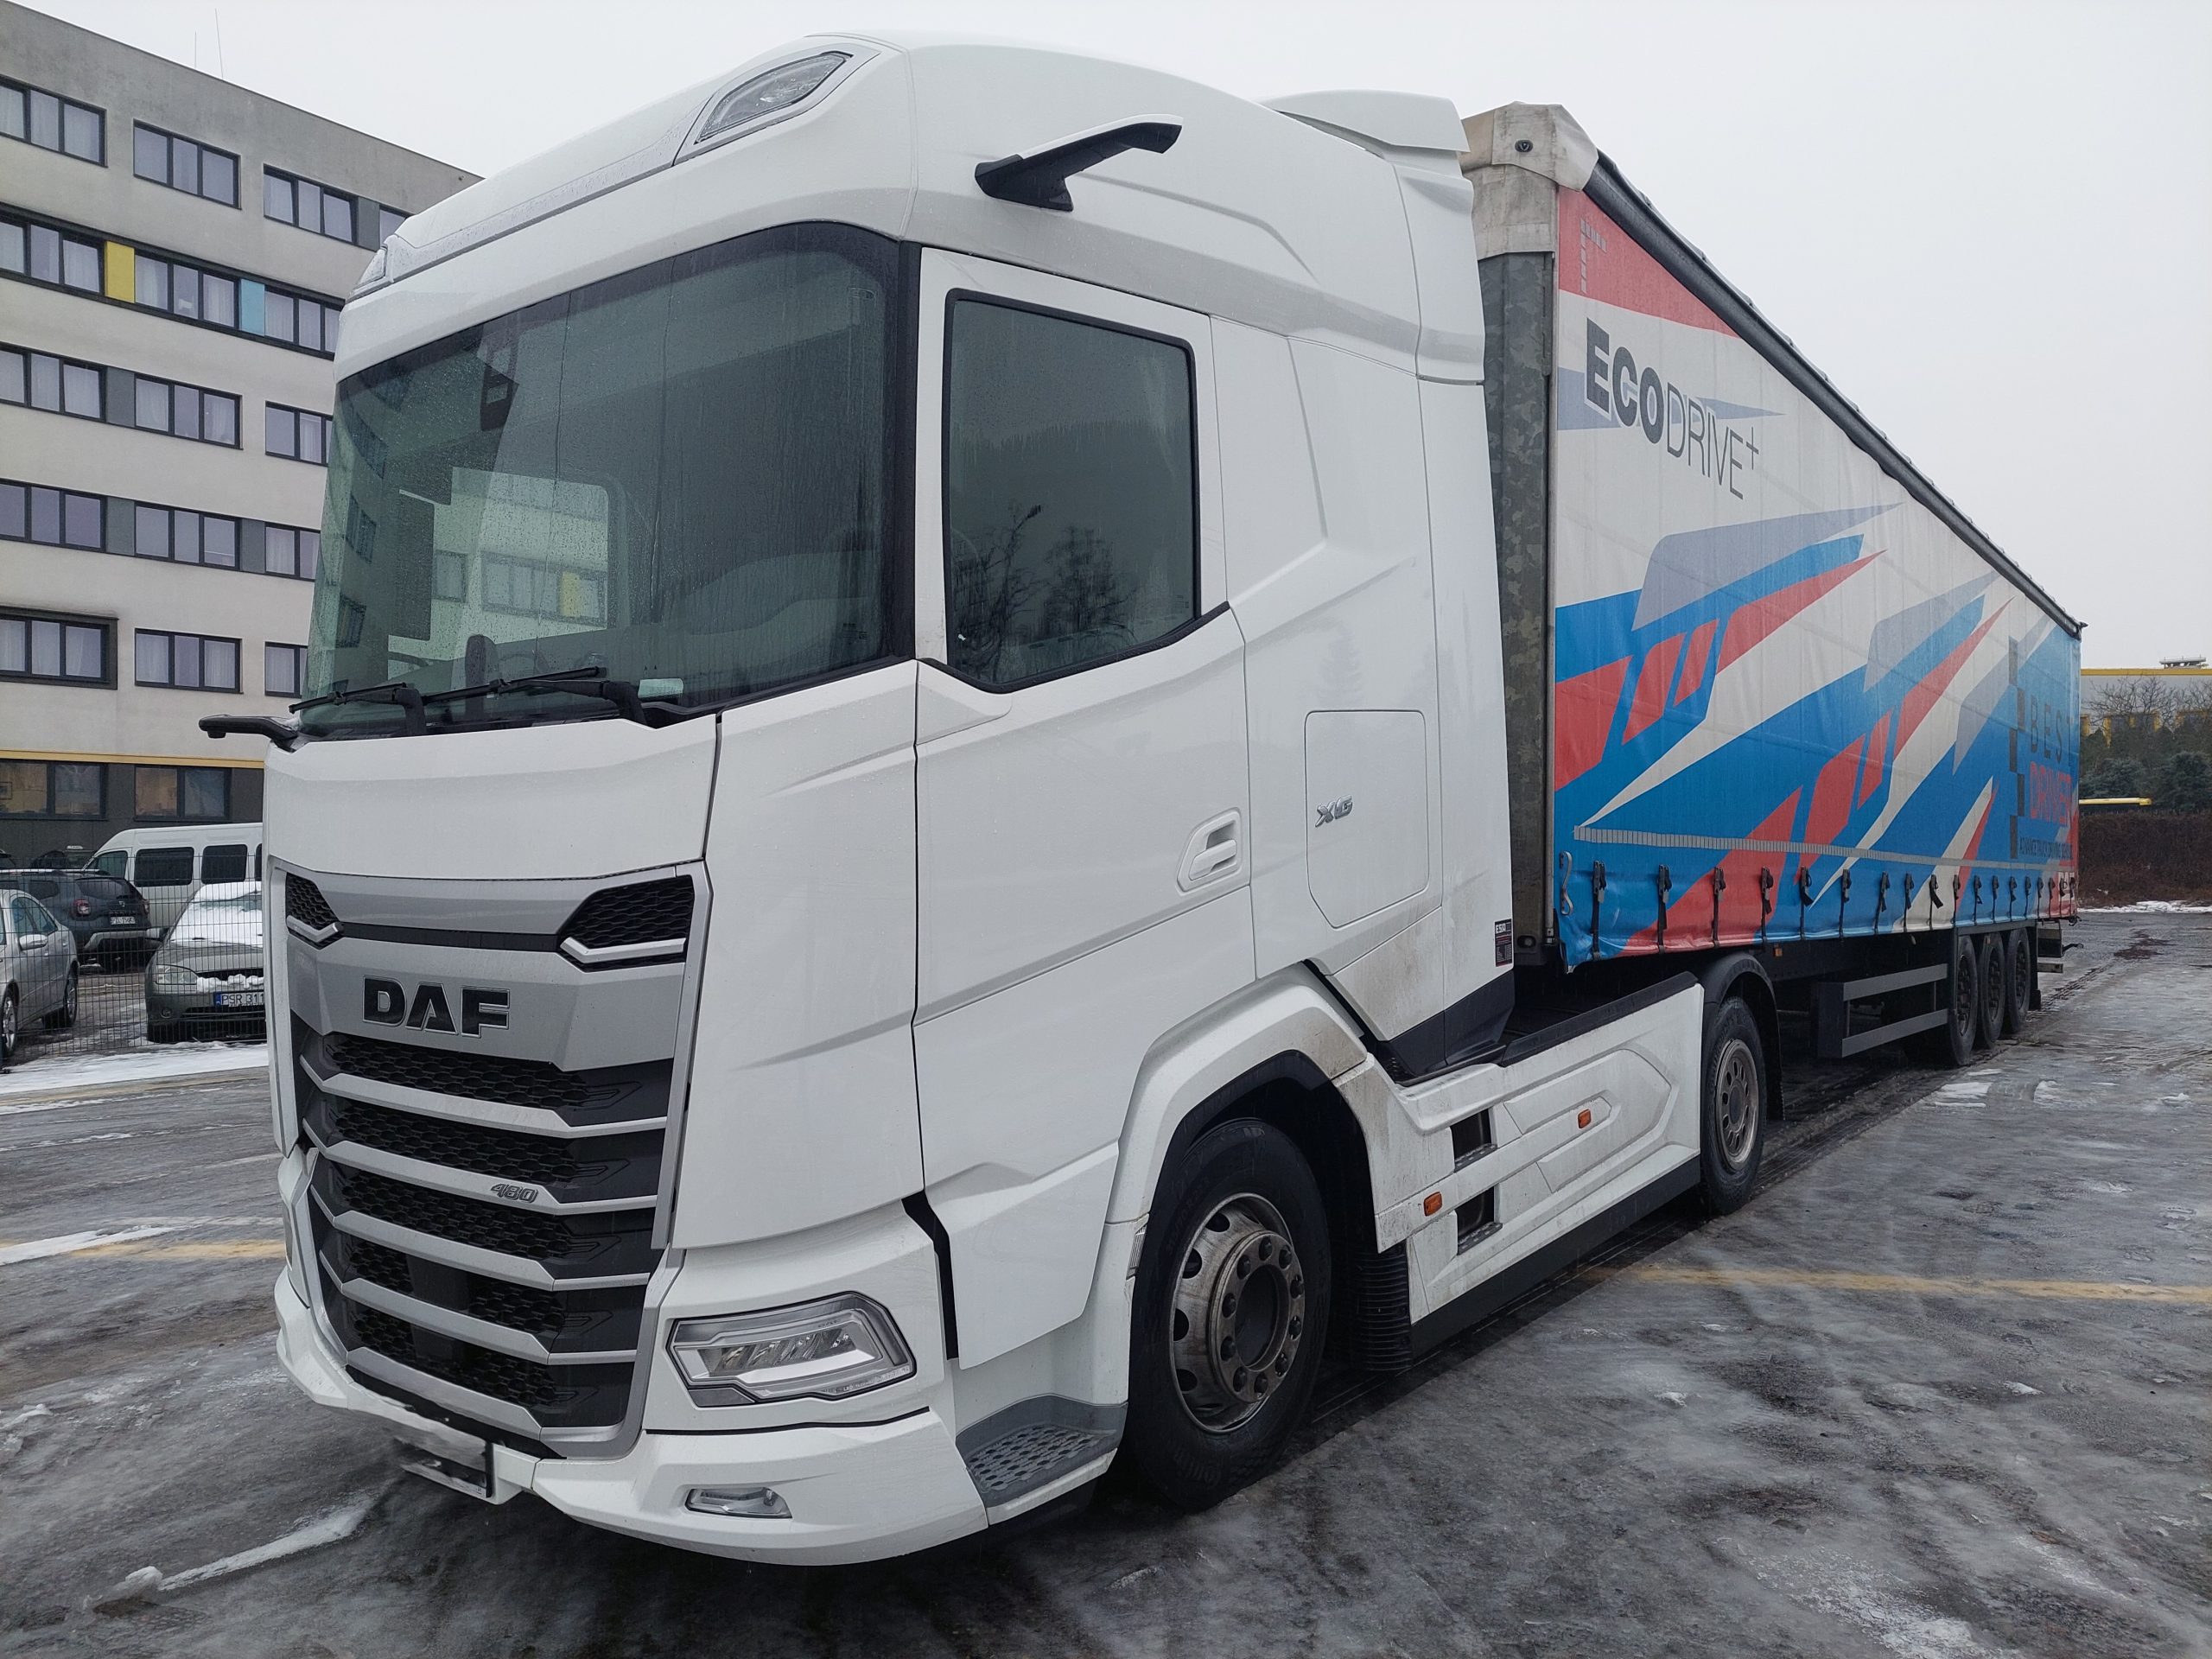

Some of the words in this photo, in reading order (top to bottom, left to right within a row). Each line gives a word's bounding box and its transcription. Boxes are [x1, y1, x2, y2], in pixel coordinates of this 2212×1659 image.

[2031, 695, 2073, 767] BEST
[1315, 794, 1353, 827] XG
[2030, 761, 2072, 825] DRIVER
[221, 994, 242, 1005] PSR
[362, 976, 510, 1038] DAF
[490, 1182, 539, 1204] 480
